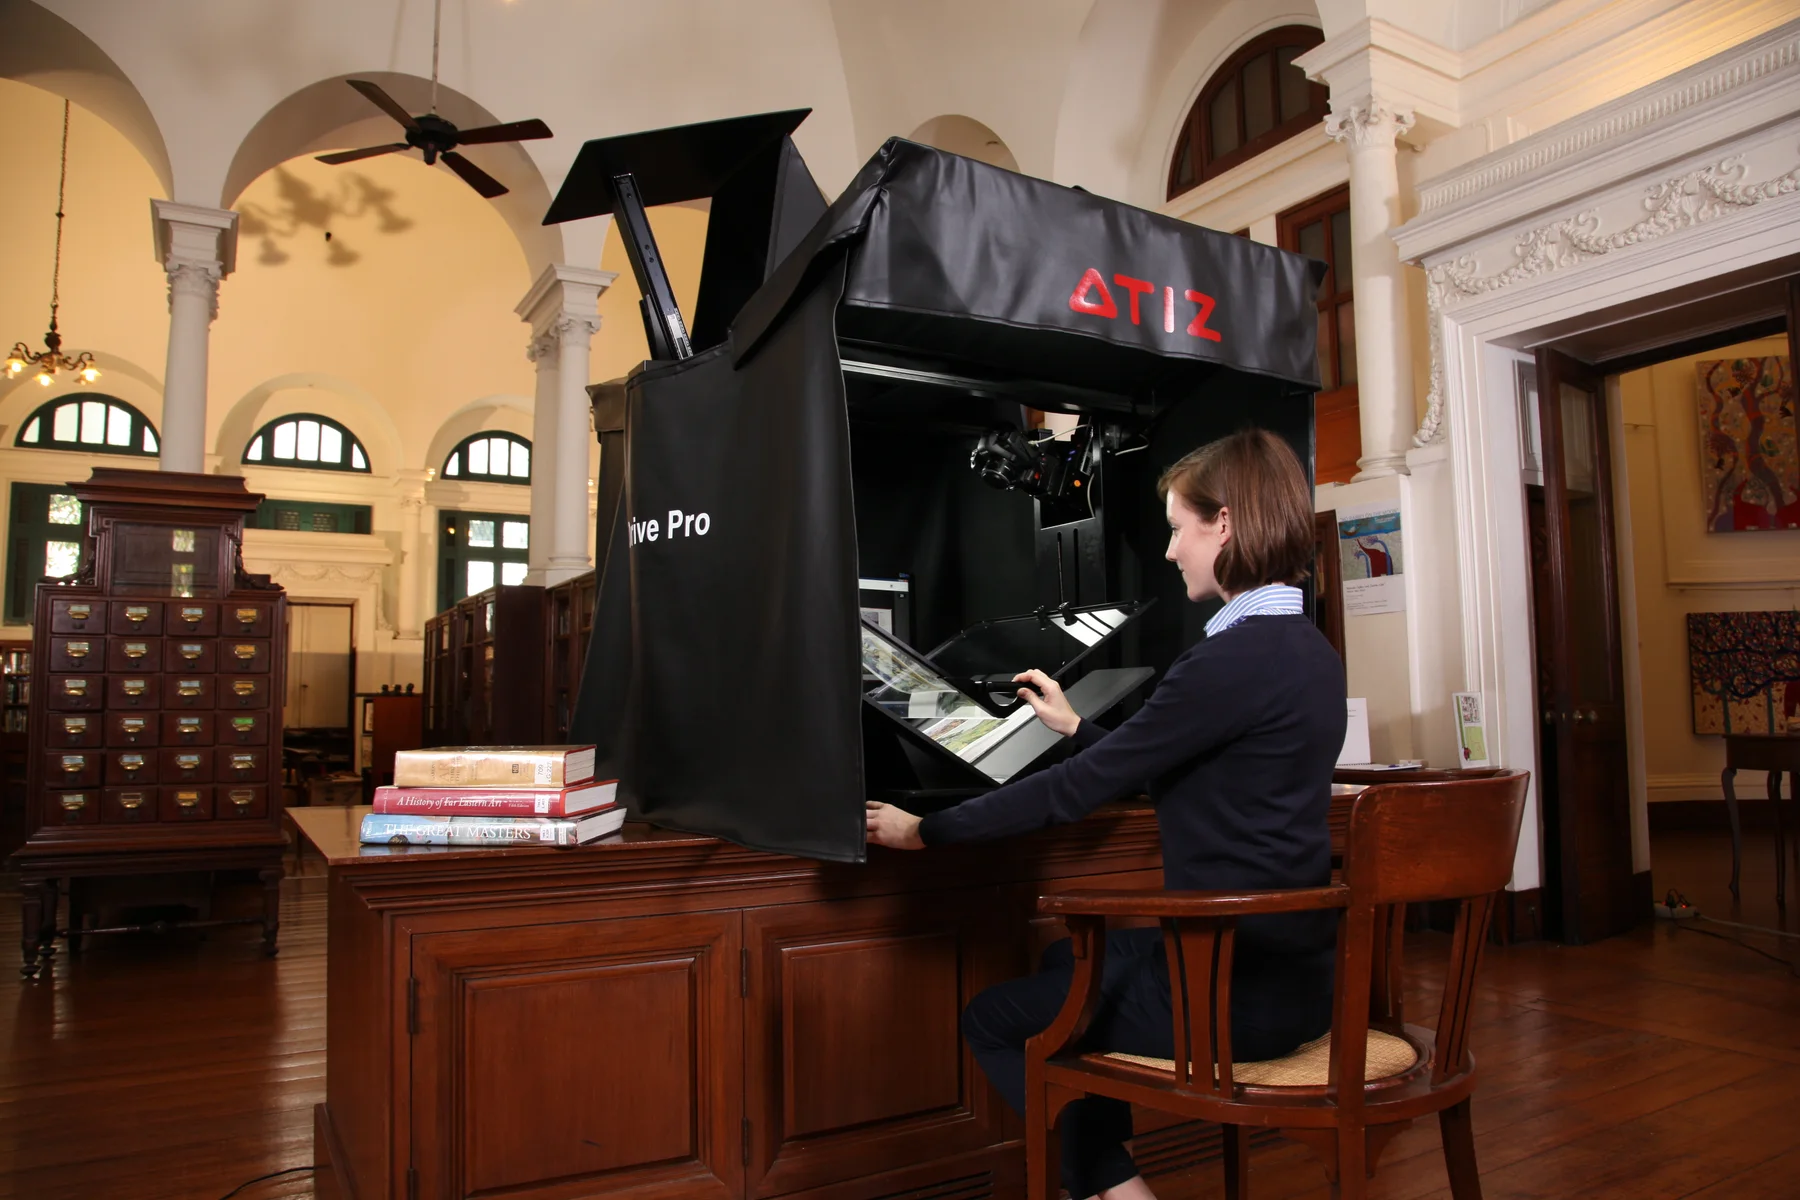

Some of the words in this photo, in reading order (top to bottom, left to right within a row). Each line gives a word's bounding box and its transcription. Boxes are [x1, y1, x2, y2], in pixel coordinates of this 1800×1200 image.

[1069, 268, 1222, 342] ATIZ
[667, 509, 710, 539] Pro
[396, 796, 404, 806] A
[405, 796, 434, 810] History
[435, 796, 445, 810] of
[444, 796, 457, 807] Far
[458, 797, 487, 807] Eastern
[487, 796, 503, 808] Art
[384, 823, 413, 836] THE
[416, 824, 461, 837] GREAT
[466, 826, 531, 840] MASTERS
